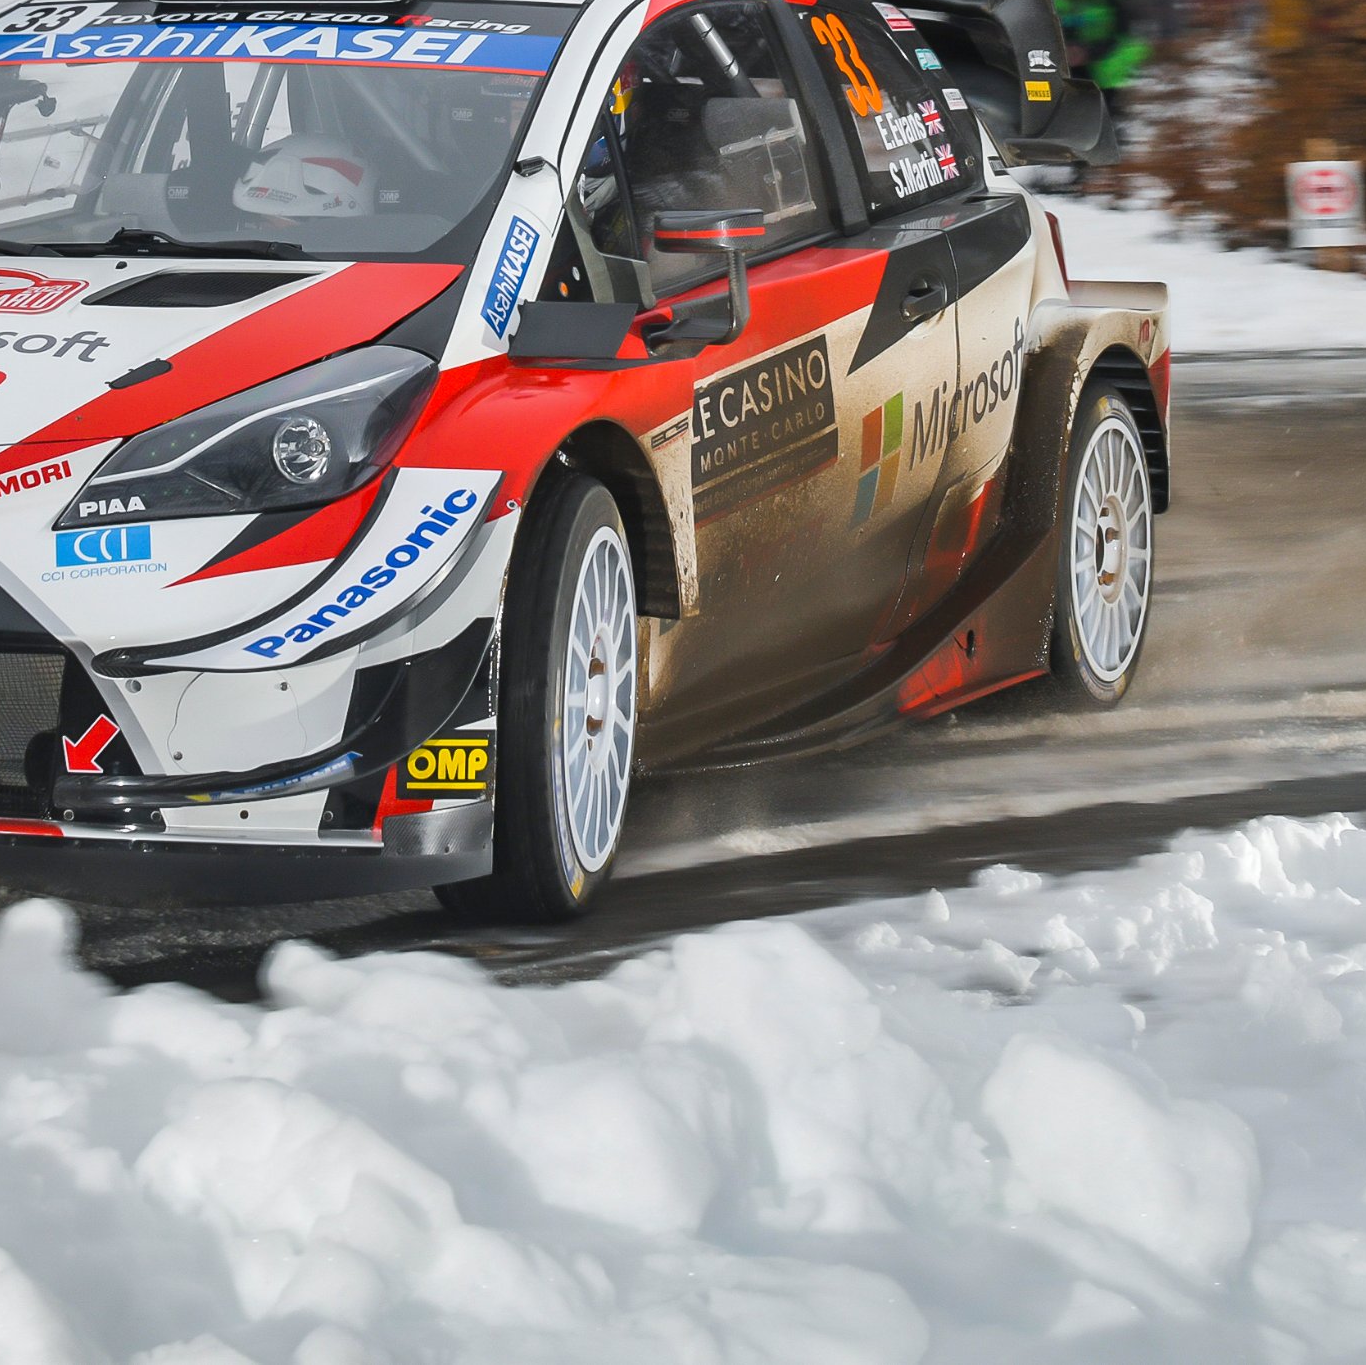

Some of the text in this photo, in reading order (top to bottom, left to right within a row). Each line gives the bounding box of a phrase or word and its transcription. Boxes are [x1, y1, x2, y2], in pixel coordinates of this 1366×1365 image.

[3, 6, 531, 35] 33 TOYOTA GAZOO Racing
[810, 13, 884, 118] 33
[875, 111, 928, 152] E.Evans
[889, 151, 943, 199] S.Martin
[378, 191, 401, 202] OMP
[486, 220, 535, 333] AsahiKASEI
[719, 349, 827, 428] CASINO
[78, 496, 147, 518] PIAA
[41, 563, 168, 583] CCI CORPORATION
[242, 488, 479, 659] Panasonic
[406, 747, 489, 781] OMP
